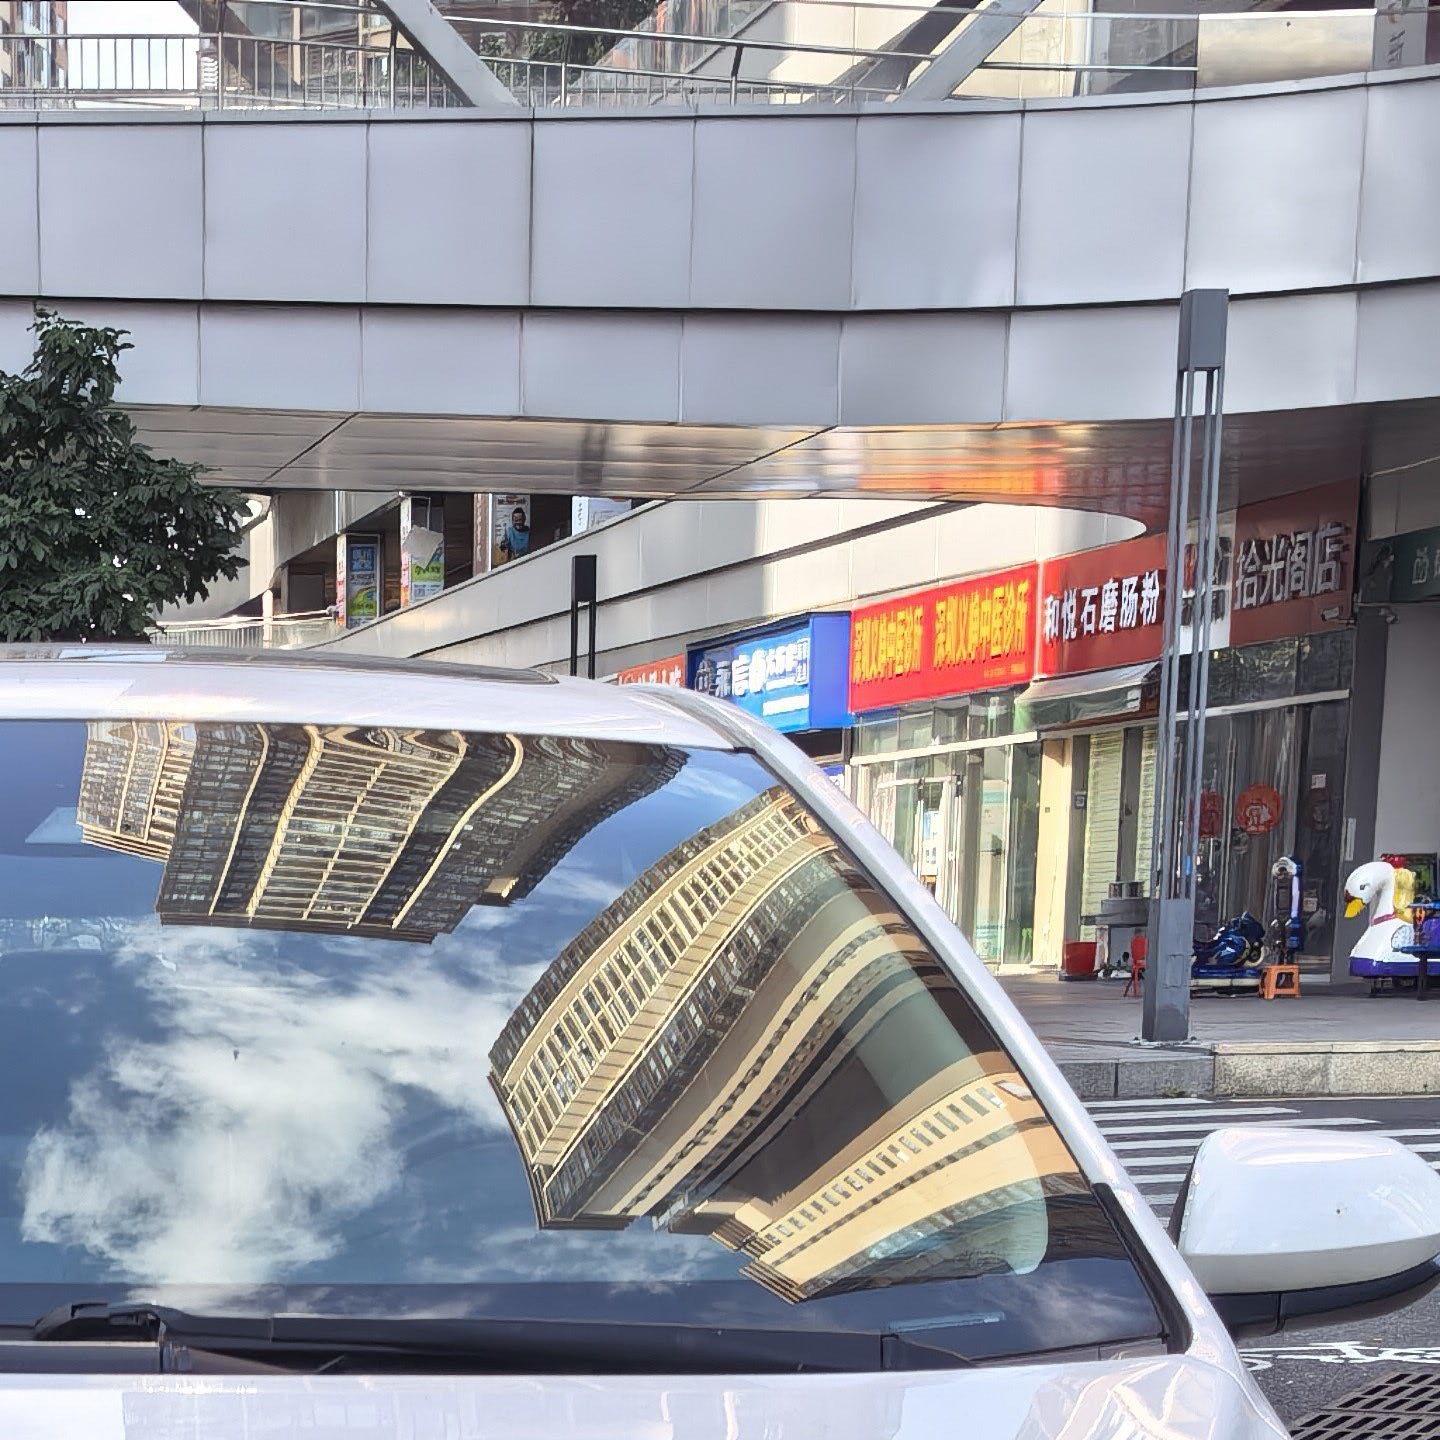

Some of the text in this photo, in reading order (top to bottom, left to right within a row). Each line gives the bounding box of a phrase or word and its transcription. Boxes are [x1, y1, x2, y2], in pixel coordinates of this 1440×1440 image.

[1234, 521, 1346, 609] 拾光阁店
[1043, 569, 1160, 643] 和悦石磨肠粉
